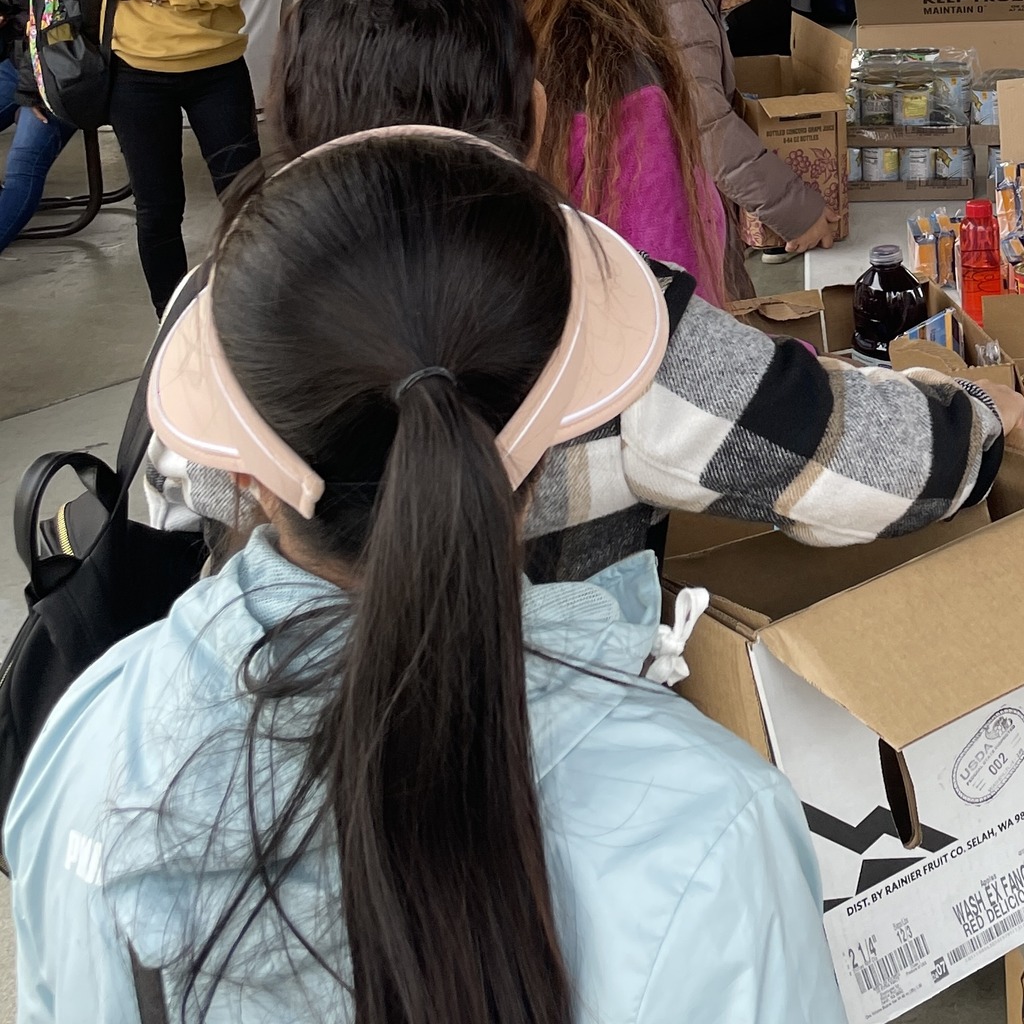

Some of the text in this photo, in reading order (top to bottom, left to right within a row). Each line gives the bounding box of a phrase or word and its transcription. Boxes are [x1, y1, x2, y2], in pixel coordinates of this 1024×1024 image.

[923, 5, 974, 15] MAINTAIN
[960, 743, 994, 780] USDA
[988, 752, 1008, 776] 002
[846, 898, 870, 917] DIST.
[871, 889, 884, 903] BY
[885, 869, 922, 896] RAINIER
[923, 854, 949, 876] FRUIT
[950, 846, 966, 859] CO.
[967, 827, 998, 851] SELAH,
[997, 819, 1014, 833] WA
[952, 891, 987, 925] WASH
[985, 880, 1003, 907] EX
[962, 916, 985, 937] RED
[848, 948, 859, 969] 2
